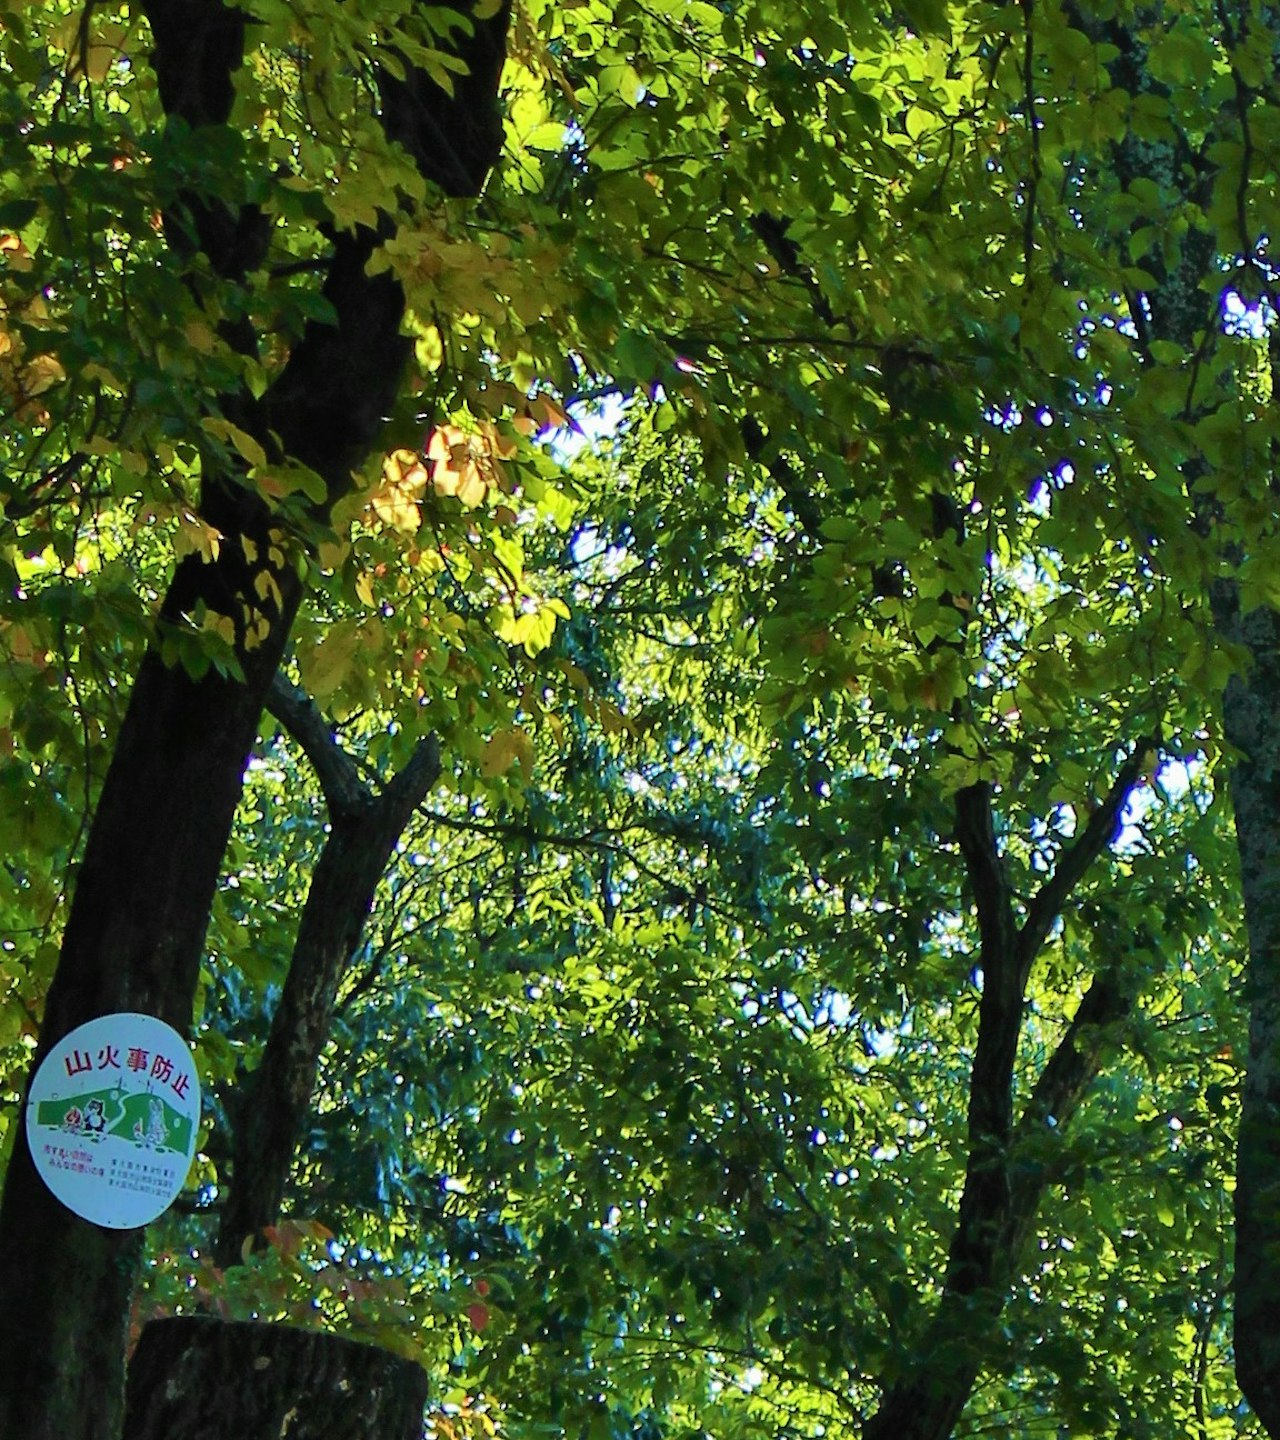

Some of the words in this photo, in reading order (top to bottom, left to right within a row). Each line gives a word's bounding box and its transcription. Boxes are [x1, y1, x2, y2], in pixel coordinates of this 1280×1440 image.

[64, 1045, 190, 1100] 山火事防止
